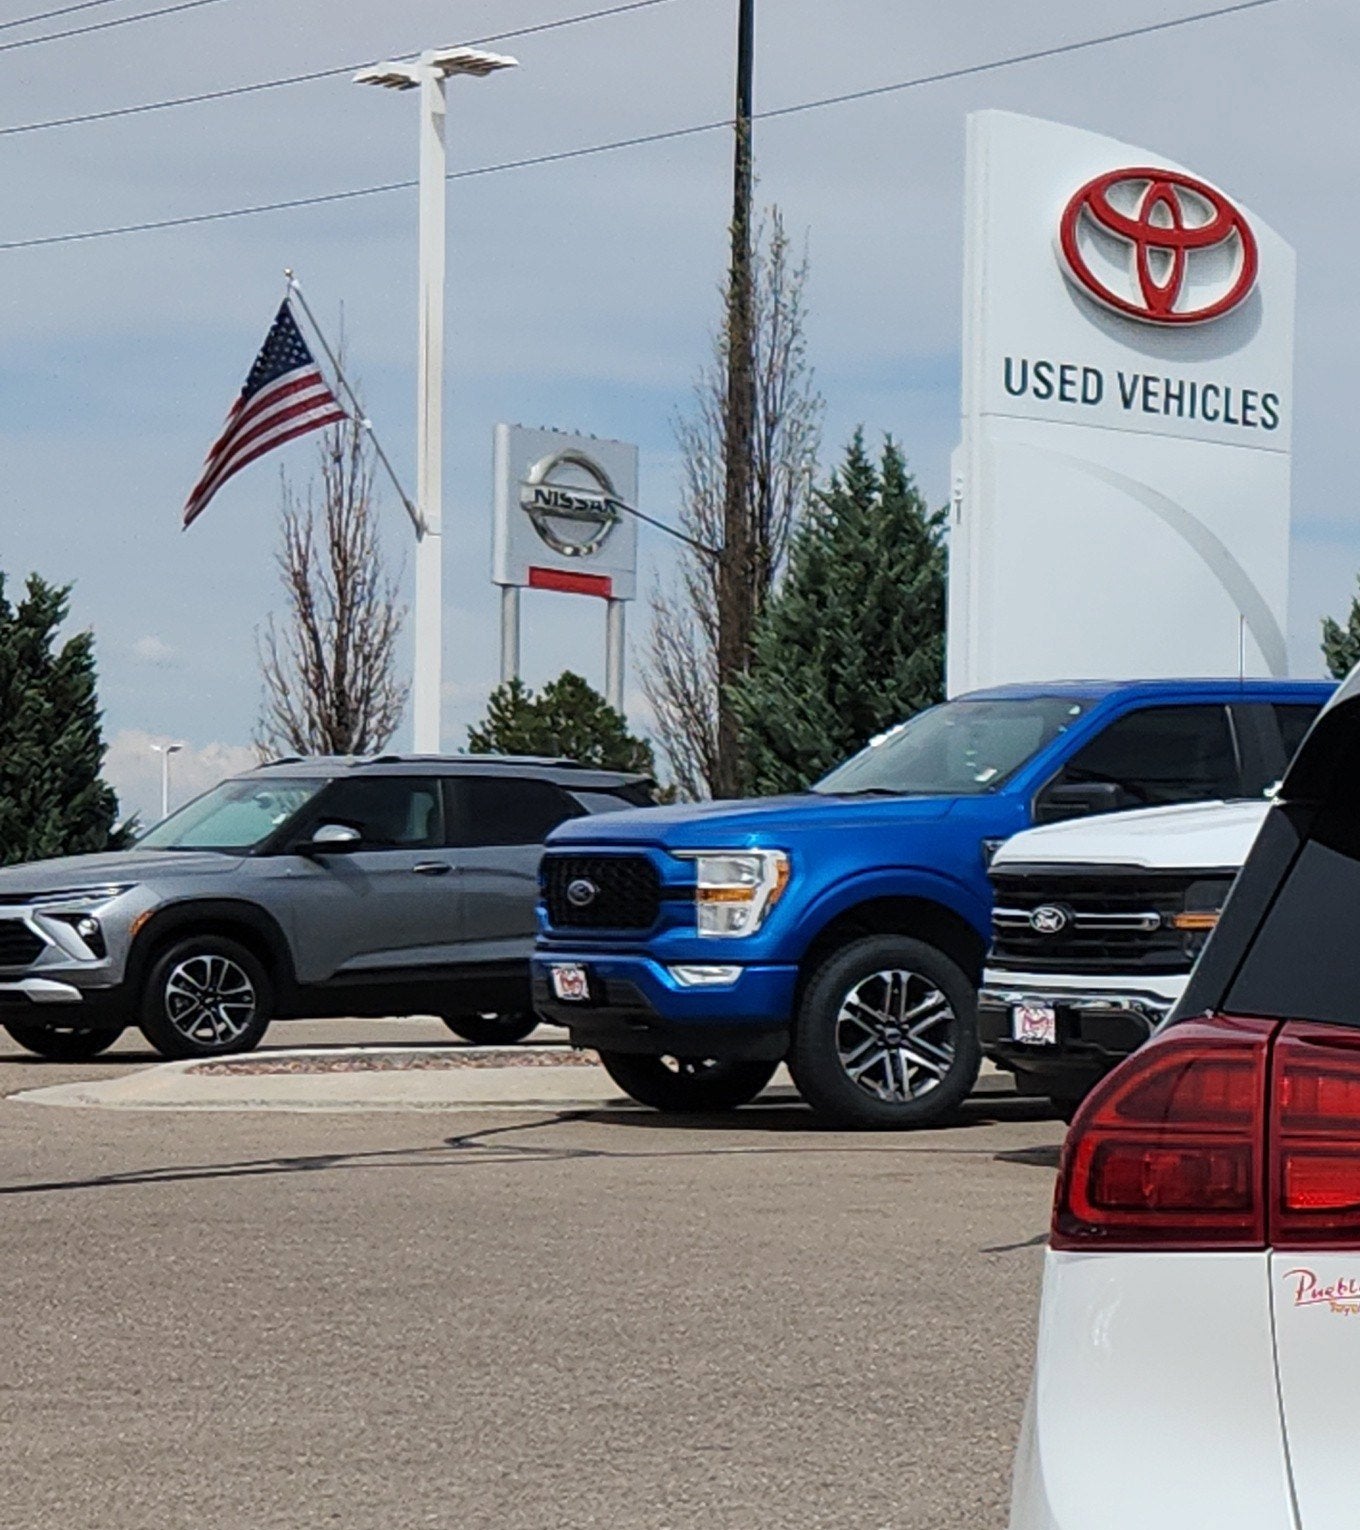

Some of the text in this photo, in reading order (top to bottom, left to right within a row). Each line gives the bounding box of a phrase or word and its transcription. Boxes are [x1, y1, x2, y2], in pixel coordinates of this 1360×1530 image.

[1004, 356, 1280, 431] USED VEHICLES
[534, 488, 618, 515] NISSAN
